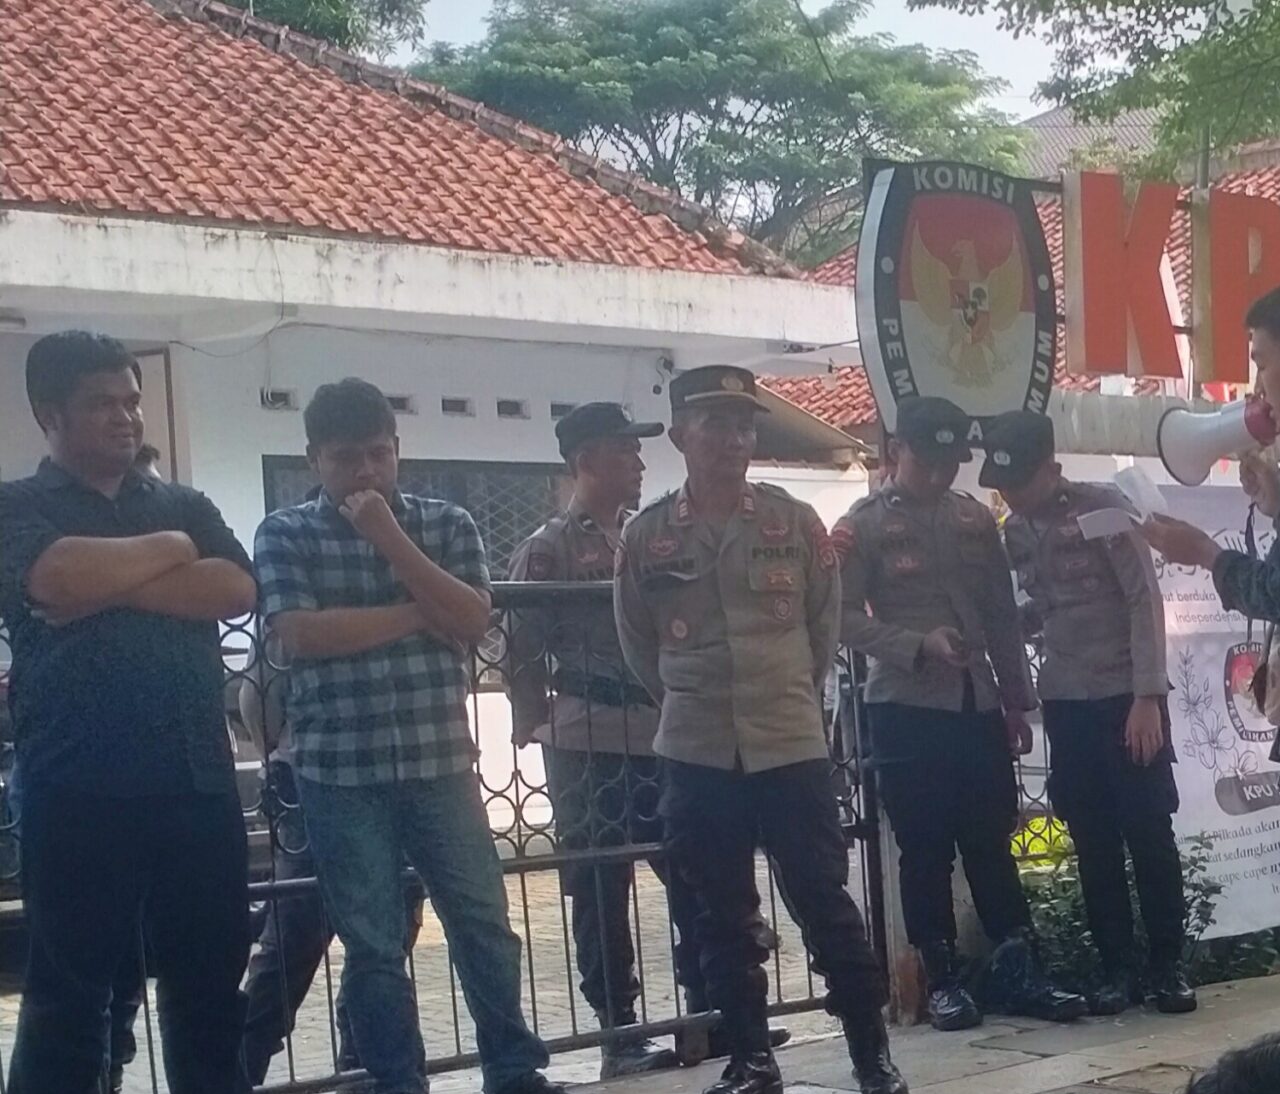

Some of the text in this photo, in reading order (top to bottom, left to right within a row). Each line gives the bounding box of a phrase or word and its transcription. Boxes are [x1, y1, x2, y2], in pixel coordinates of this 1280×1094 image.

[912, 166, 1015, 203] KOMISI
[1027, 330, 1053, 415] MUM
[752, 547, 800, 560] POLRI
[1177, 589, 1217, 602] berduka
[1243, 784, 1273, 801] KPU
[1219, 870, 1240, 885] cape
[1243, 865, 1268, 881] cape
